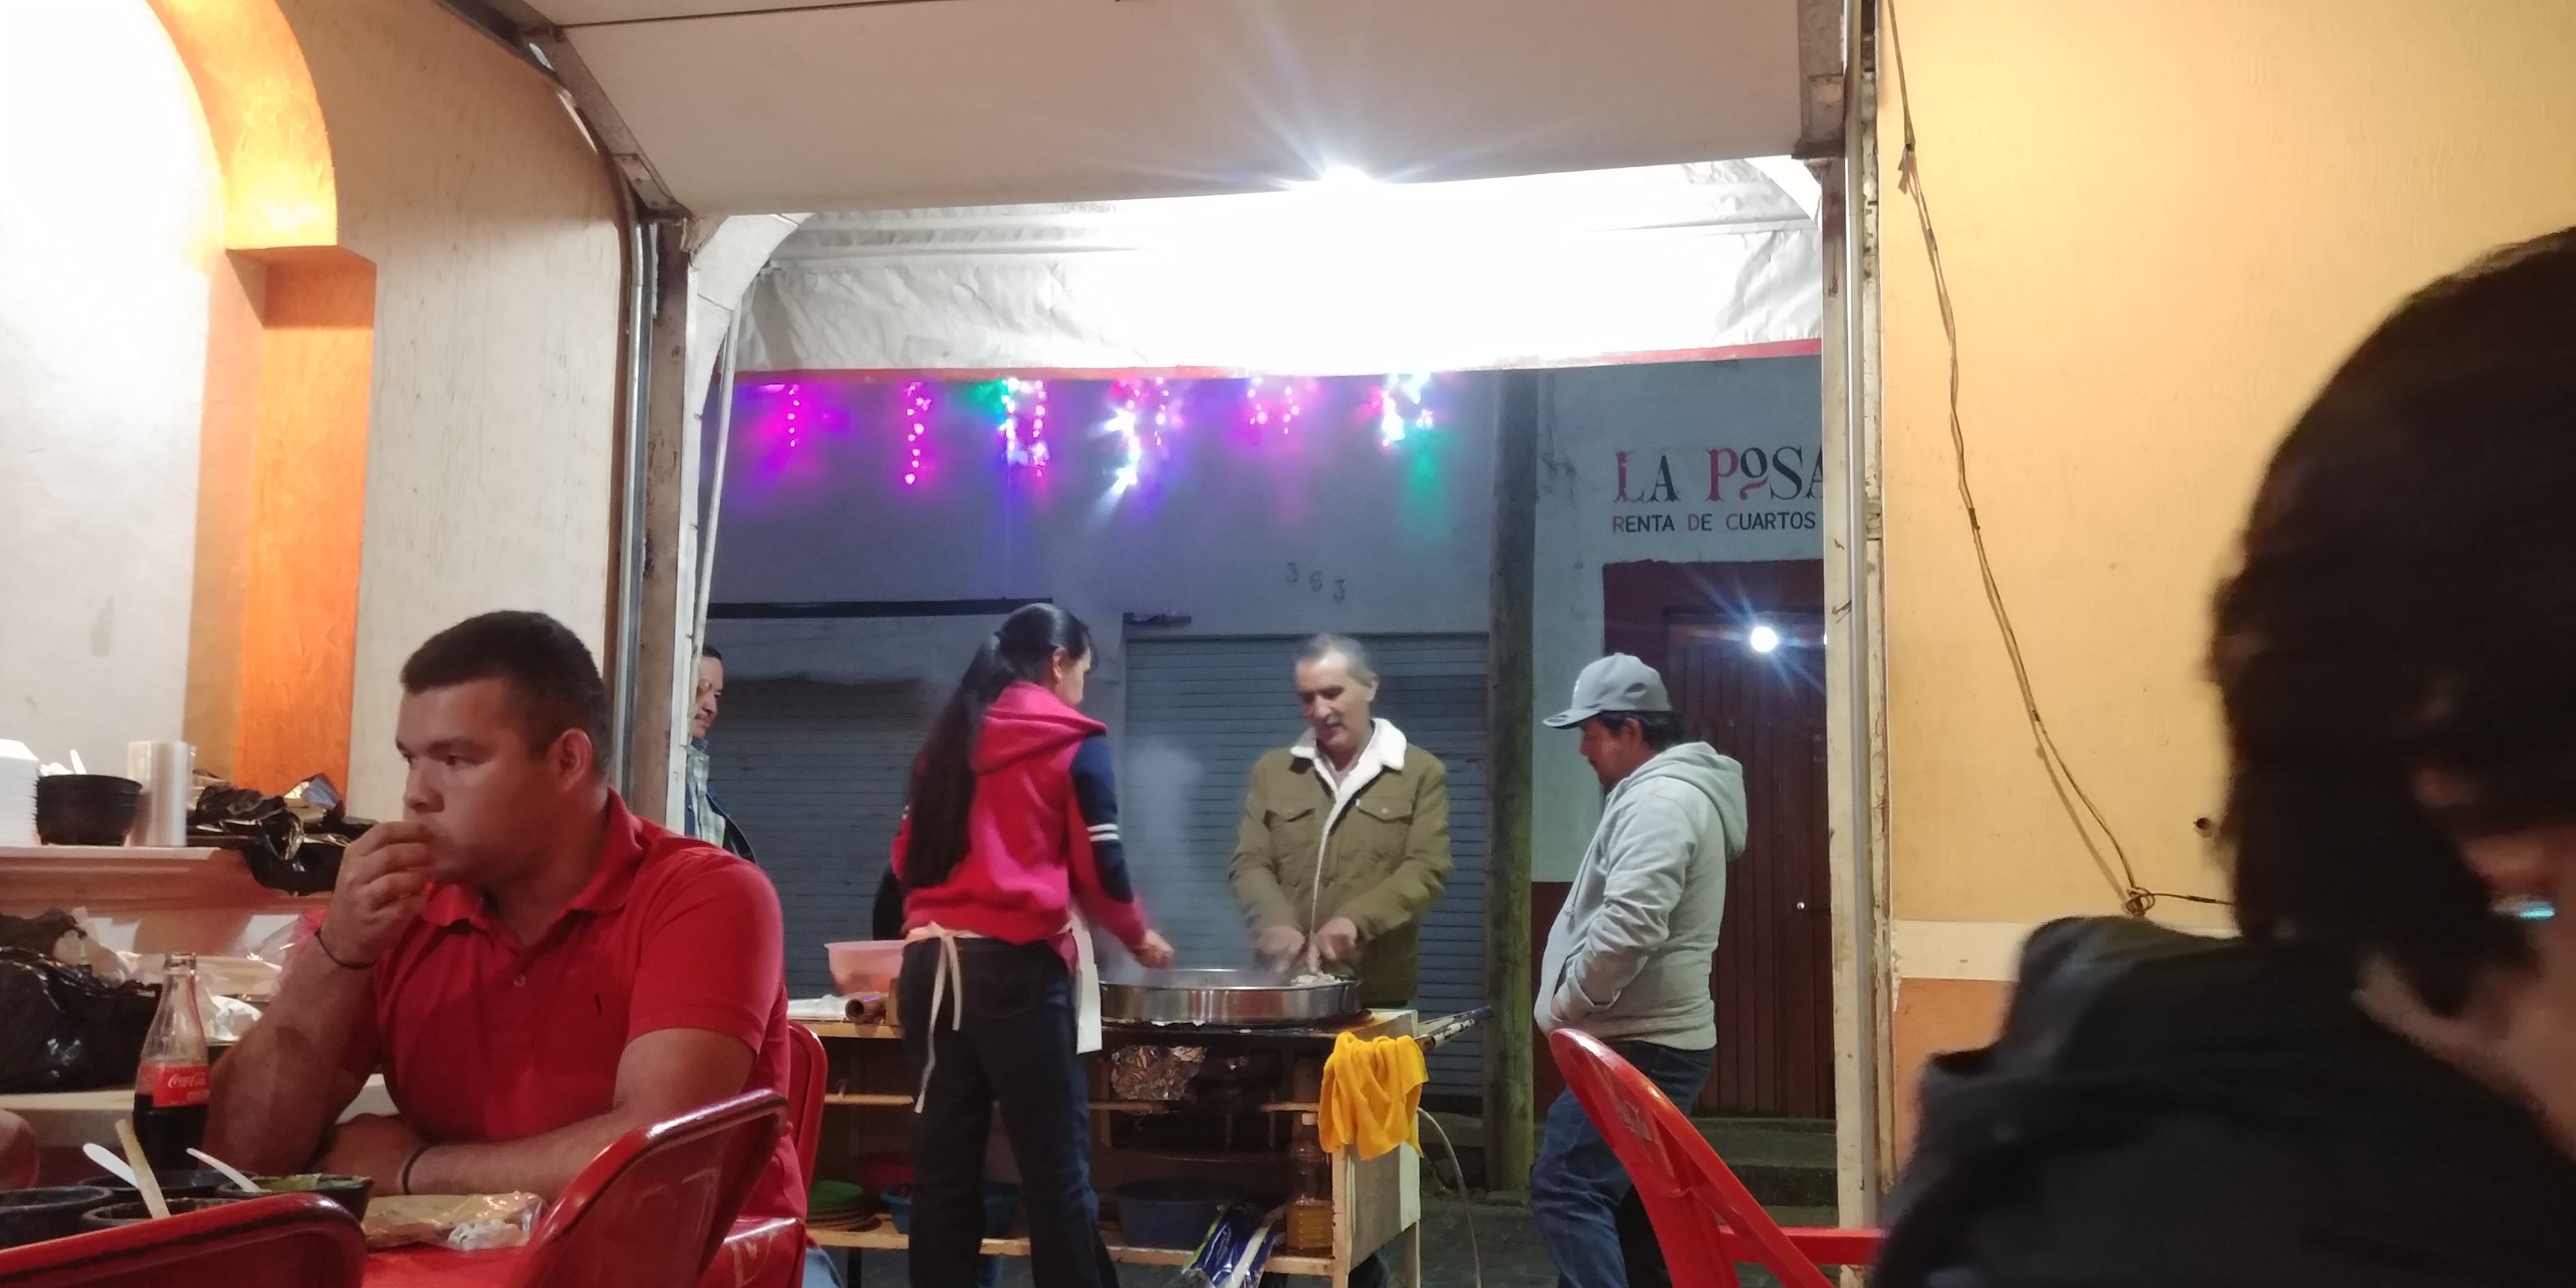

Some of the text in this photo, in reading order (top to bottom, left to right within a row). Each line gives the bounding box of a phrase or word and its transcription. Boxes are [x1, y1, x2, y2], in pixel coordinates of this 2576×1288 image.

[1612, 450, 1682, 502] LA
[1612, 511, 1816, 533] RENTA DE CUARTOS
